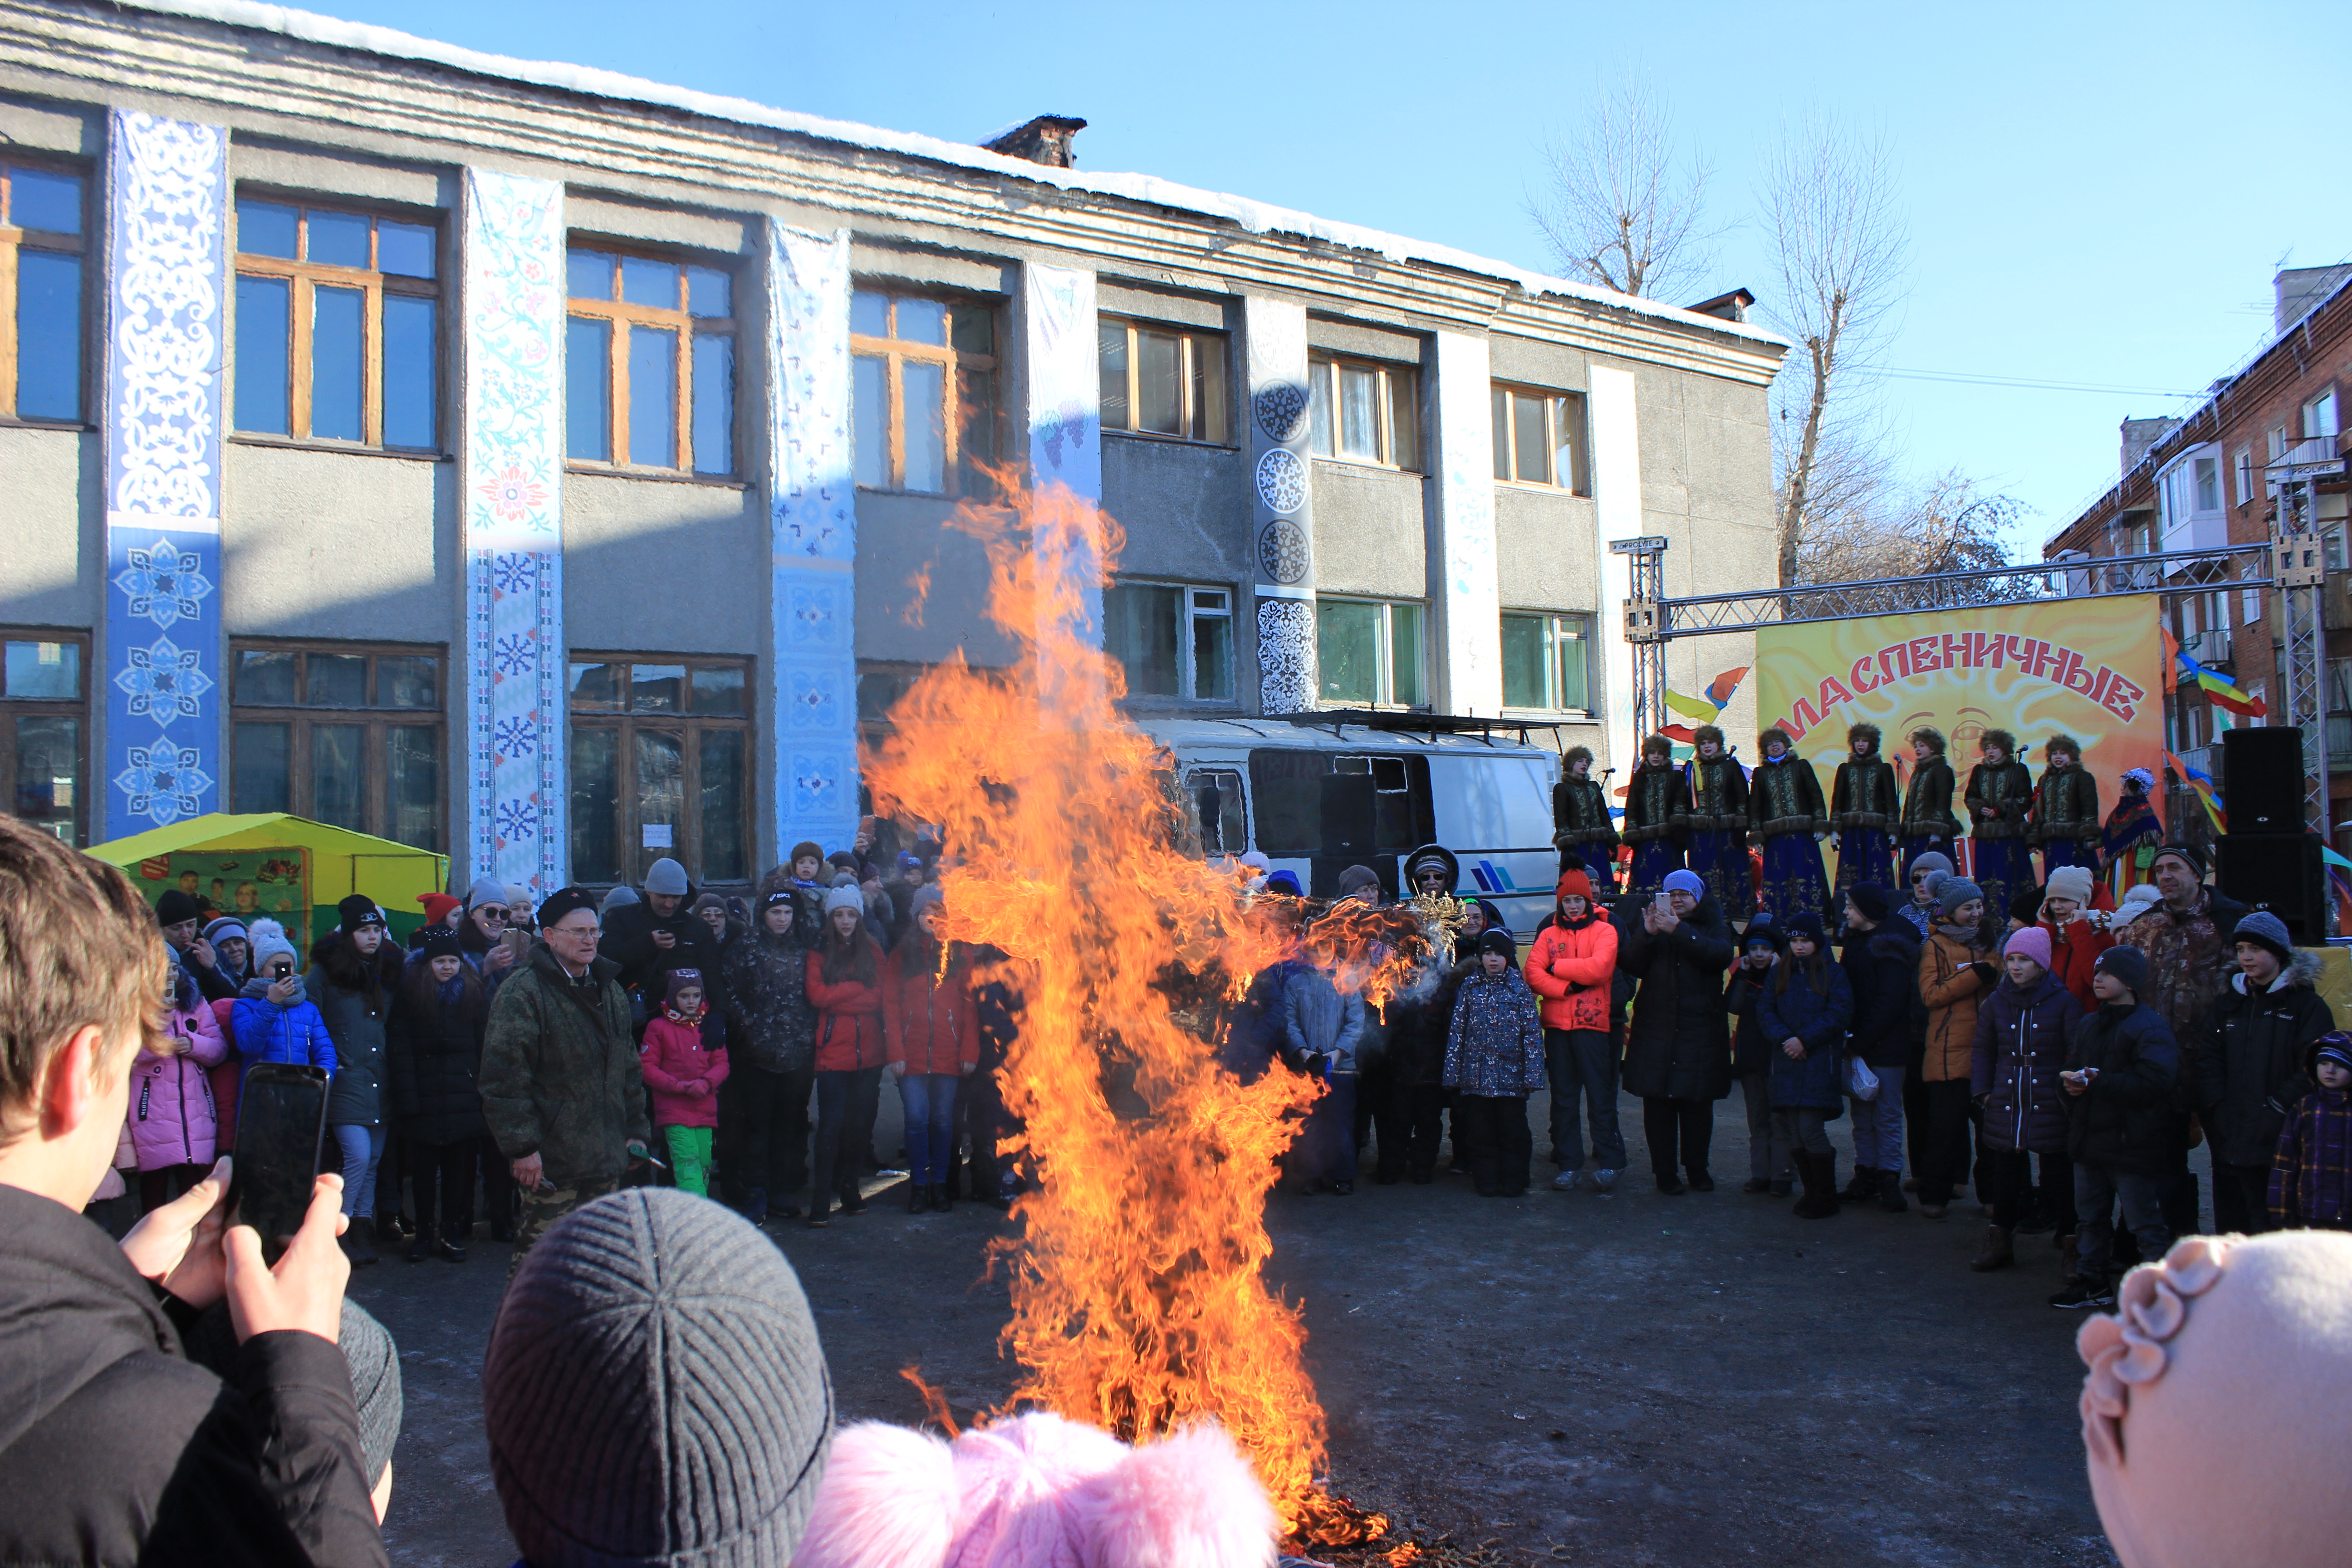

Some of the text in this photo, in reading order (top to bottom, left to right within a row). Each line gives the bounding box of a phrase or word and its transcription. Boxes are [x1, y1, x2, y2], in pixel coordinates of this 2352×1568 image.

[2292, 464, 2332, 476] PROLYTE
[1625, 539, 1653, 549] PROLYTE
[1772, 632, 2146, 742] МАСЛЕНИЧНЫЕ
